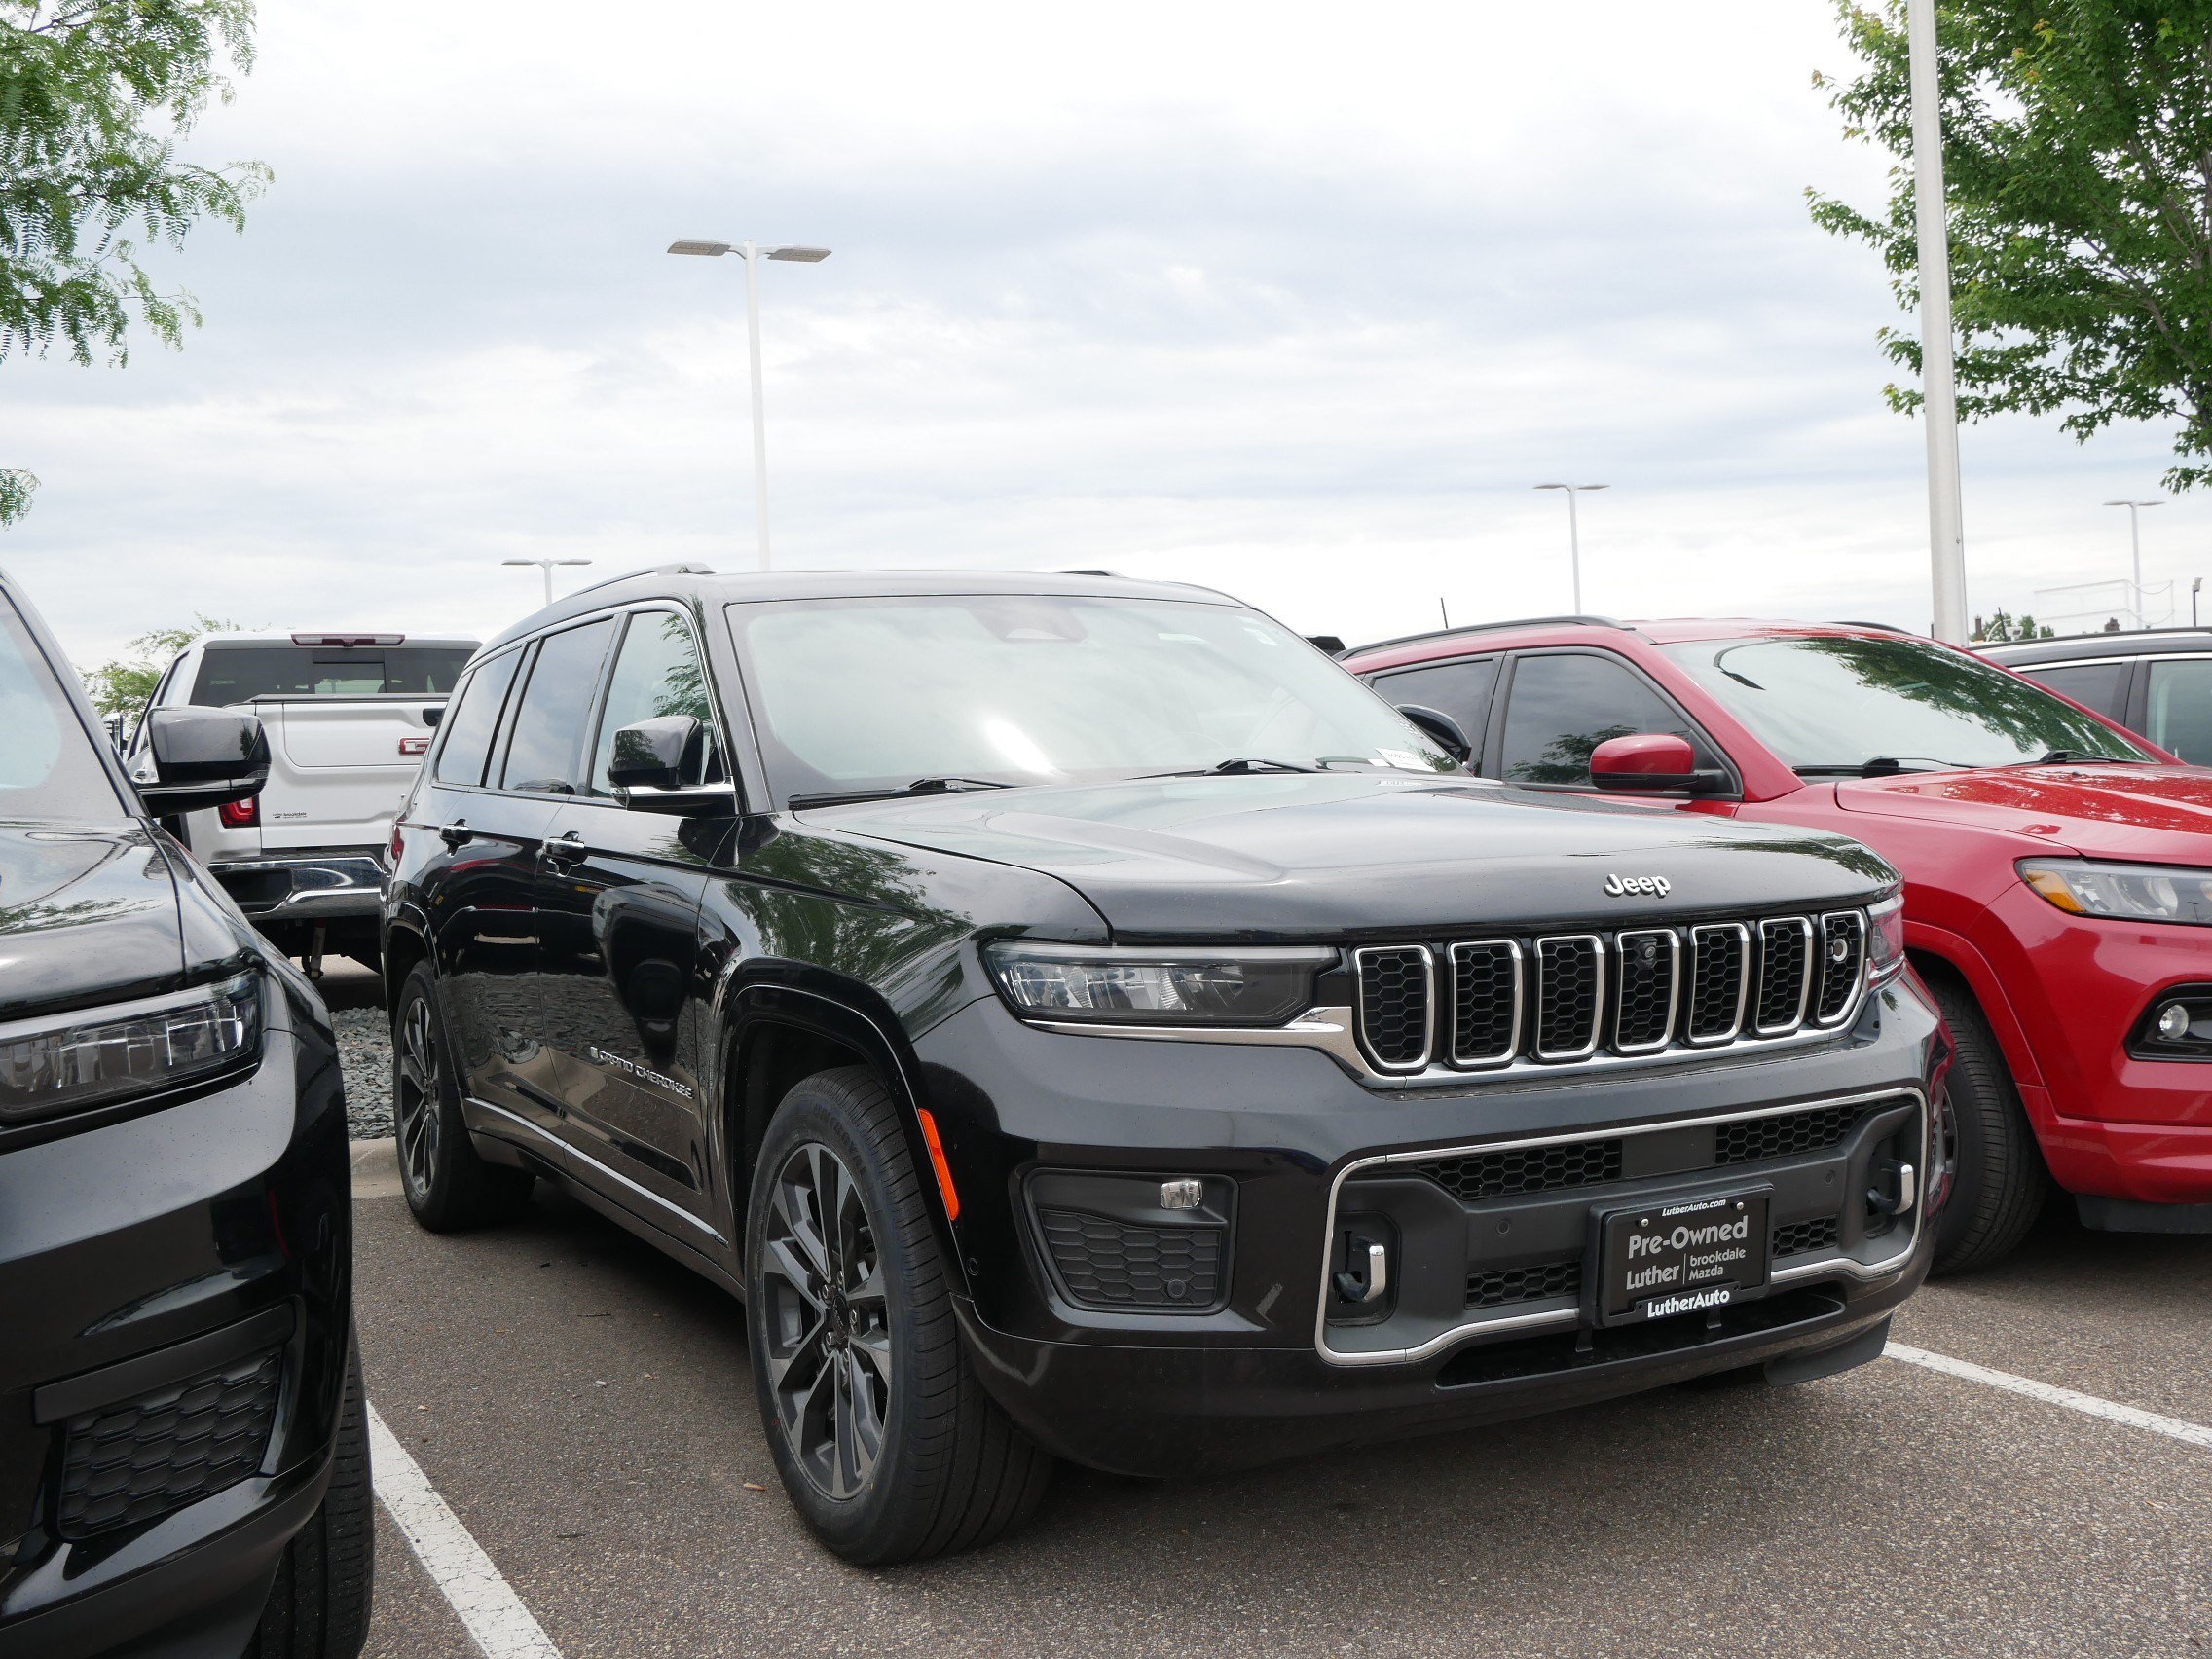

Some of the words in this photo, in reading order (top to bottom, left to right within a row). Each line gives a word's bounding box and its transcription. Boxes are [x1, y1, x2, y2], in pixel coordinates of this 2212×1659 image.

[1603, 873, 1671, 899] Jeep
[635, 1065, 694, 1099] CHEROKEE
[1661, 1198, 1727, 1217] LutherAuto.com
[1628, 1215, 1749, 1259] Pre-Owned
[1689, 1247, 1747, 1267] brookdale
[1626, 1263, 1680, 1290] Luther
[1688, 1264, 1724, 1281] Mazda
[1647, 1290, 1731, 1318] LutherAuto
